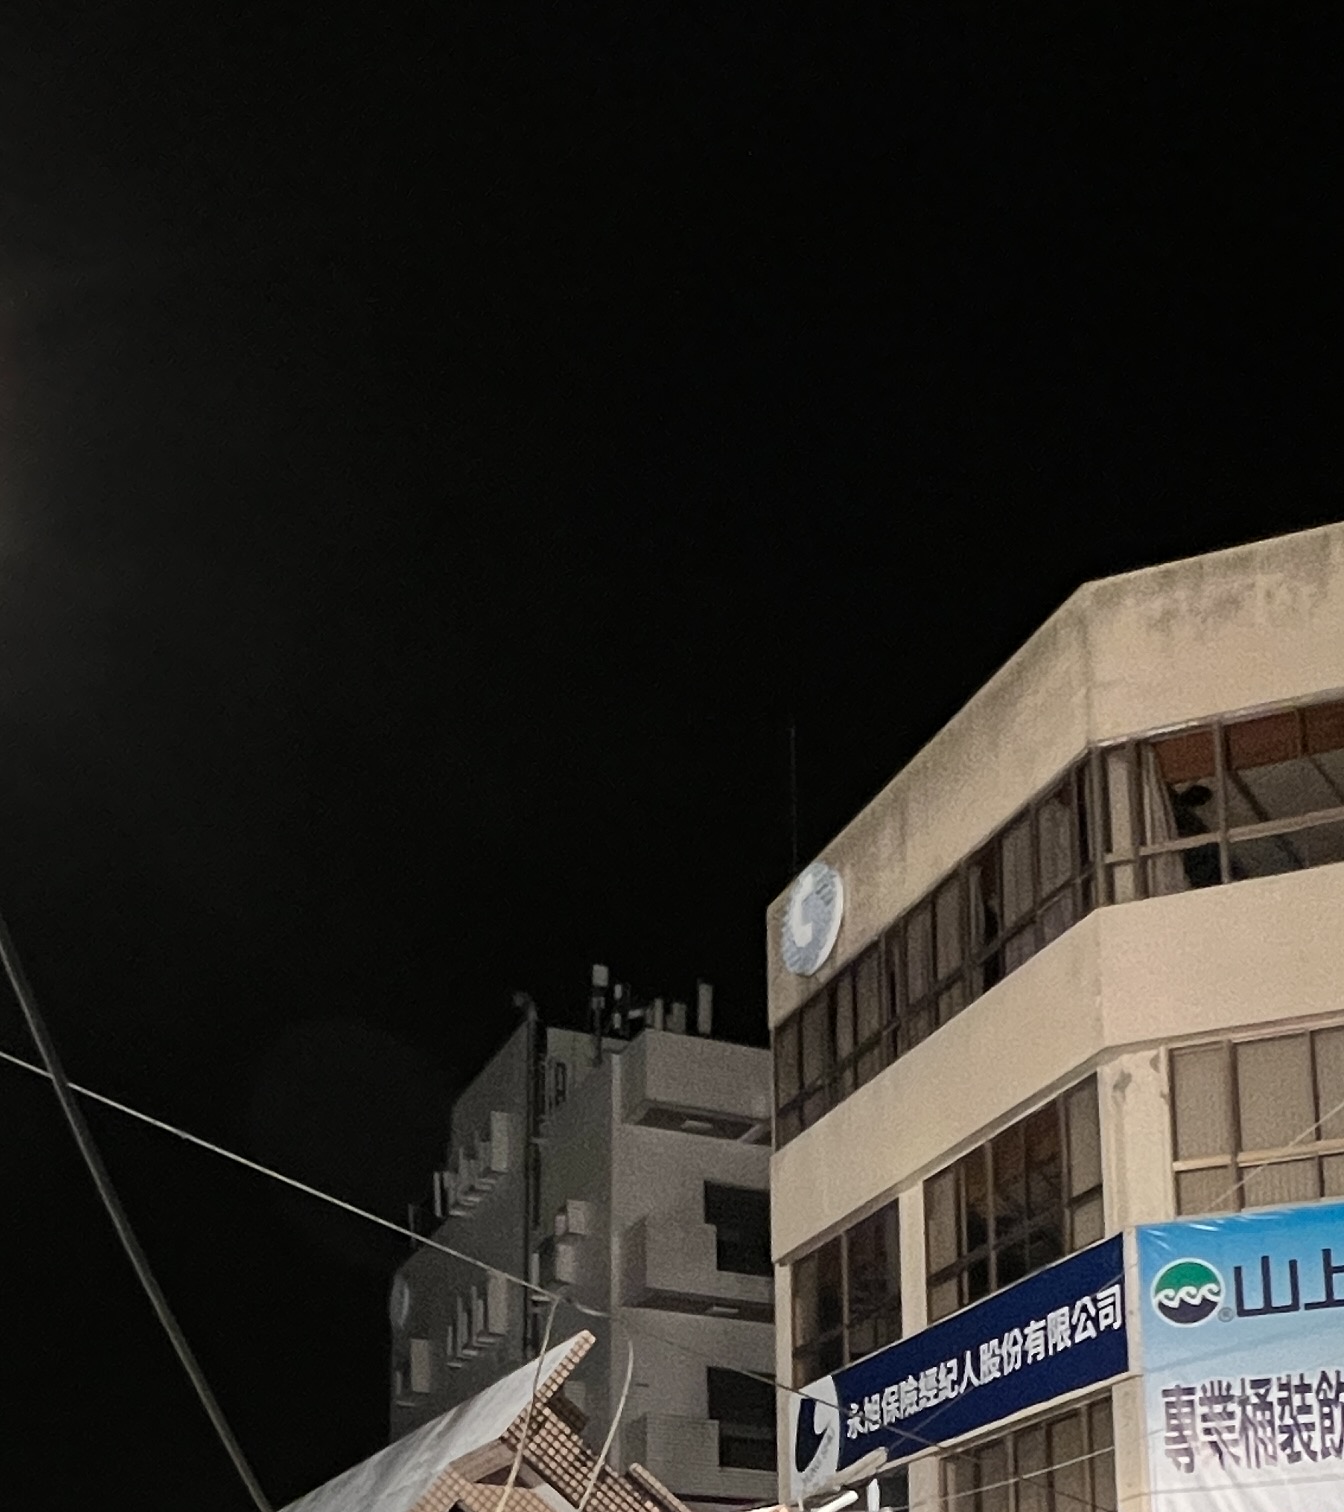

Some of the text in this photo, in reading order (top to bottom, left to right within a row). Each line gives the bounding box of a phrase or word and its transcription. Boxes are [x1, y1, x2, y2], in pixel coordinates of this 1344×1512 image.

[846, 1284, 1122, 1439] 永旭保險經紀人股份有限公司
